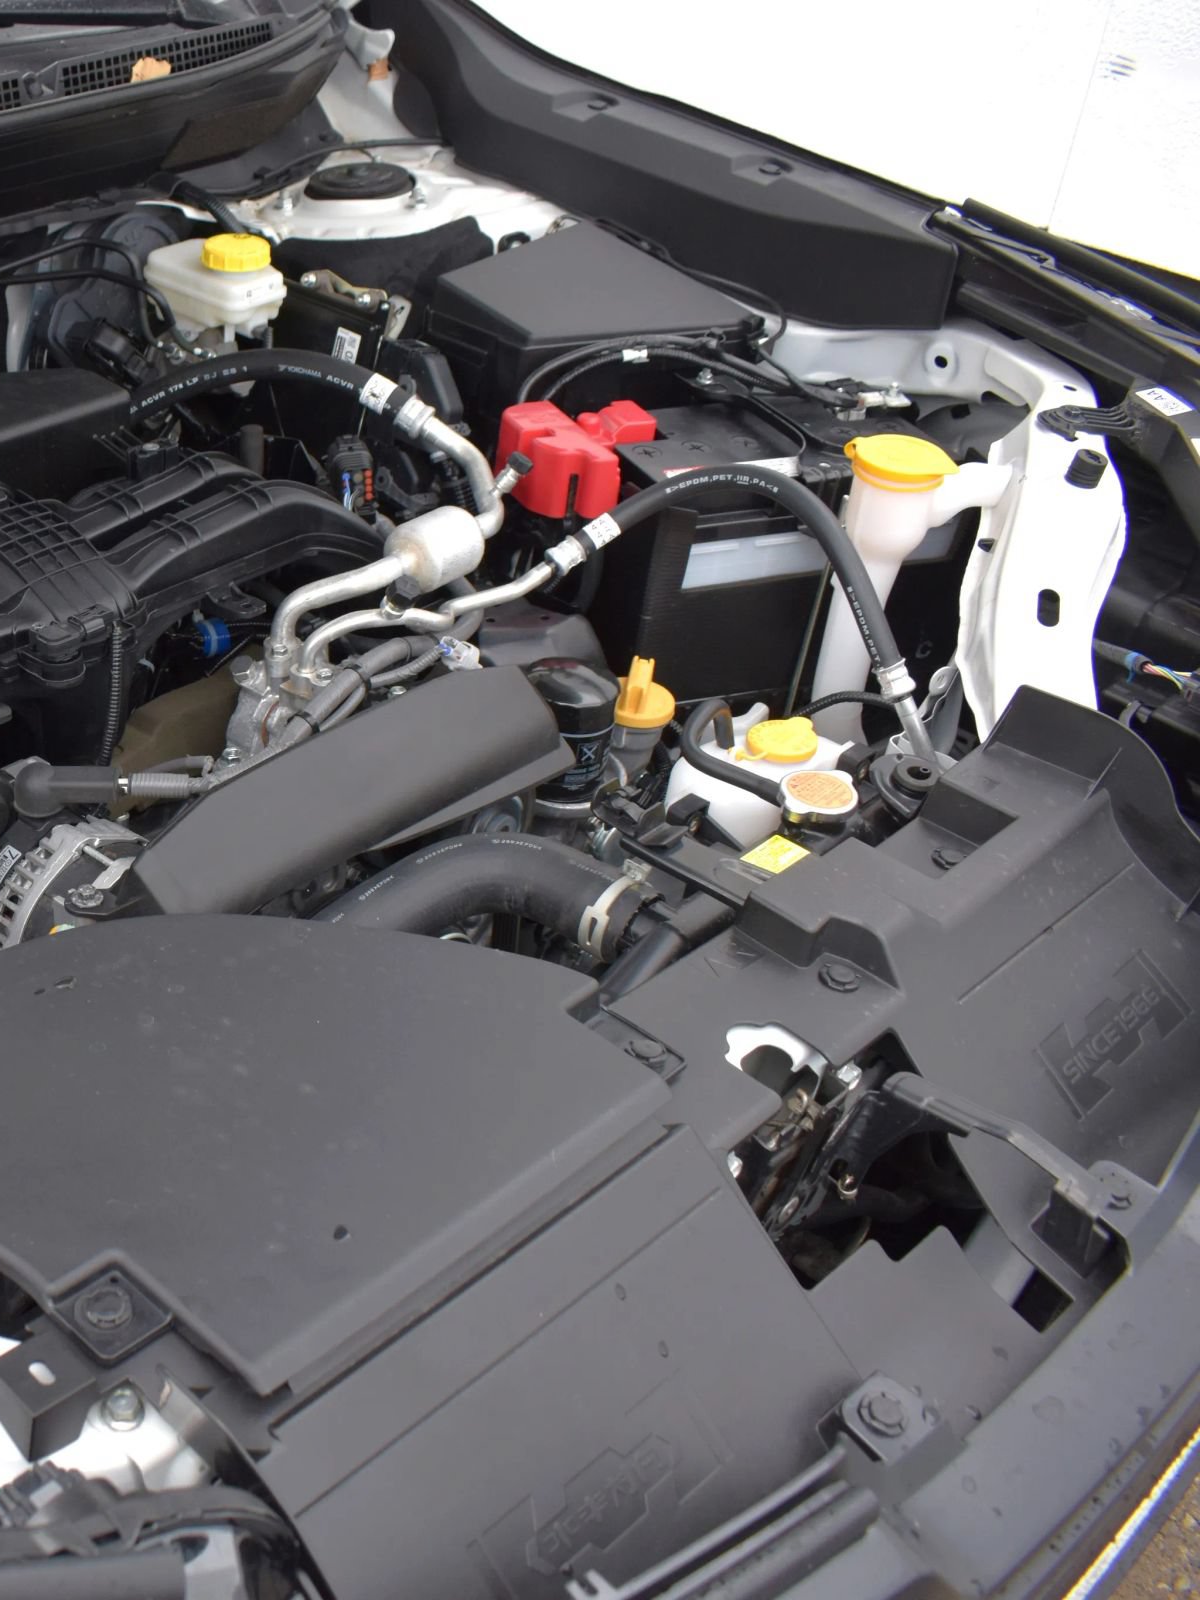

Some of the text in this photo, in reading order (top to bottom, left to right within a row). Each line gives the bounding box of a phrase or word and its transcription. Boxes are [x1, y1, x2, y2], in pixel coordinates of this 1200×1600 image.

[284, 364, 354, 389] YOKOHAMA ACVR
[141, 391, 166, 407] ACVR
[1063, 984, 1160, 1084] SINCE 1966
